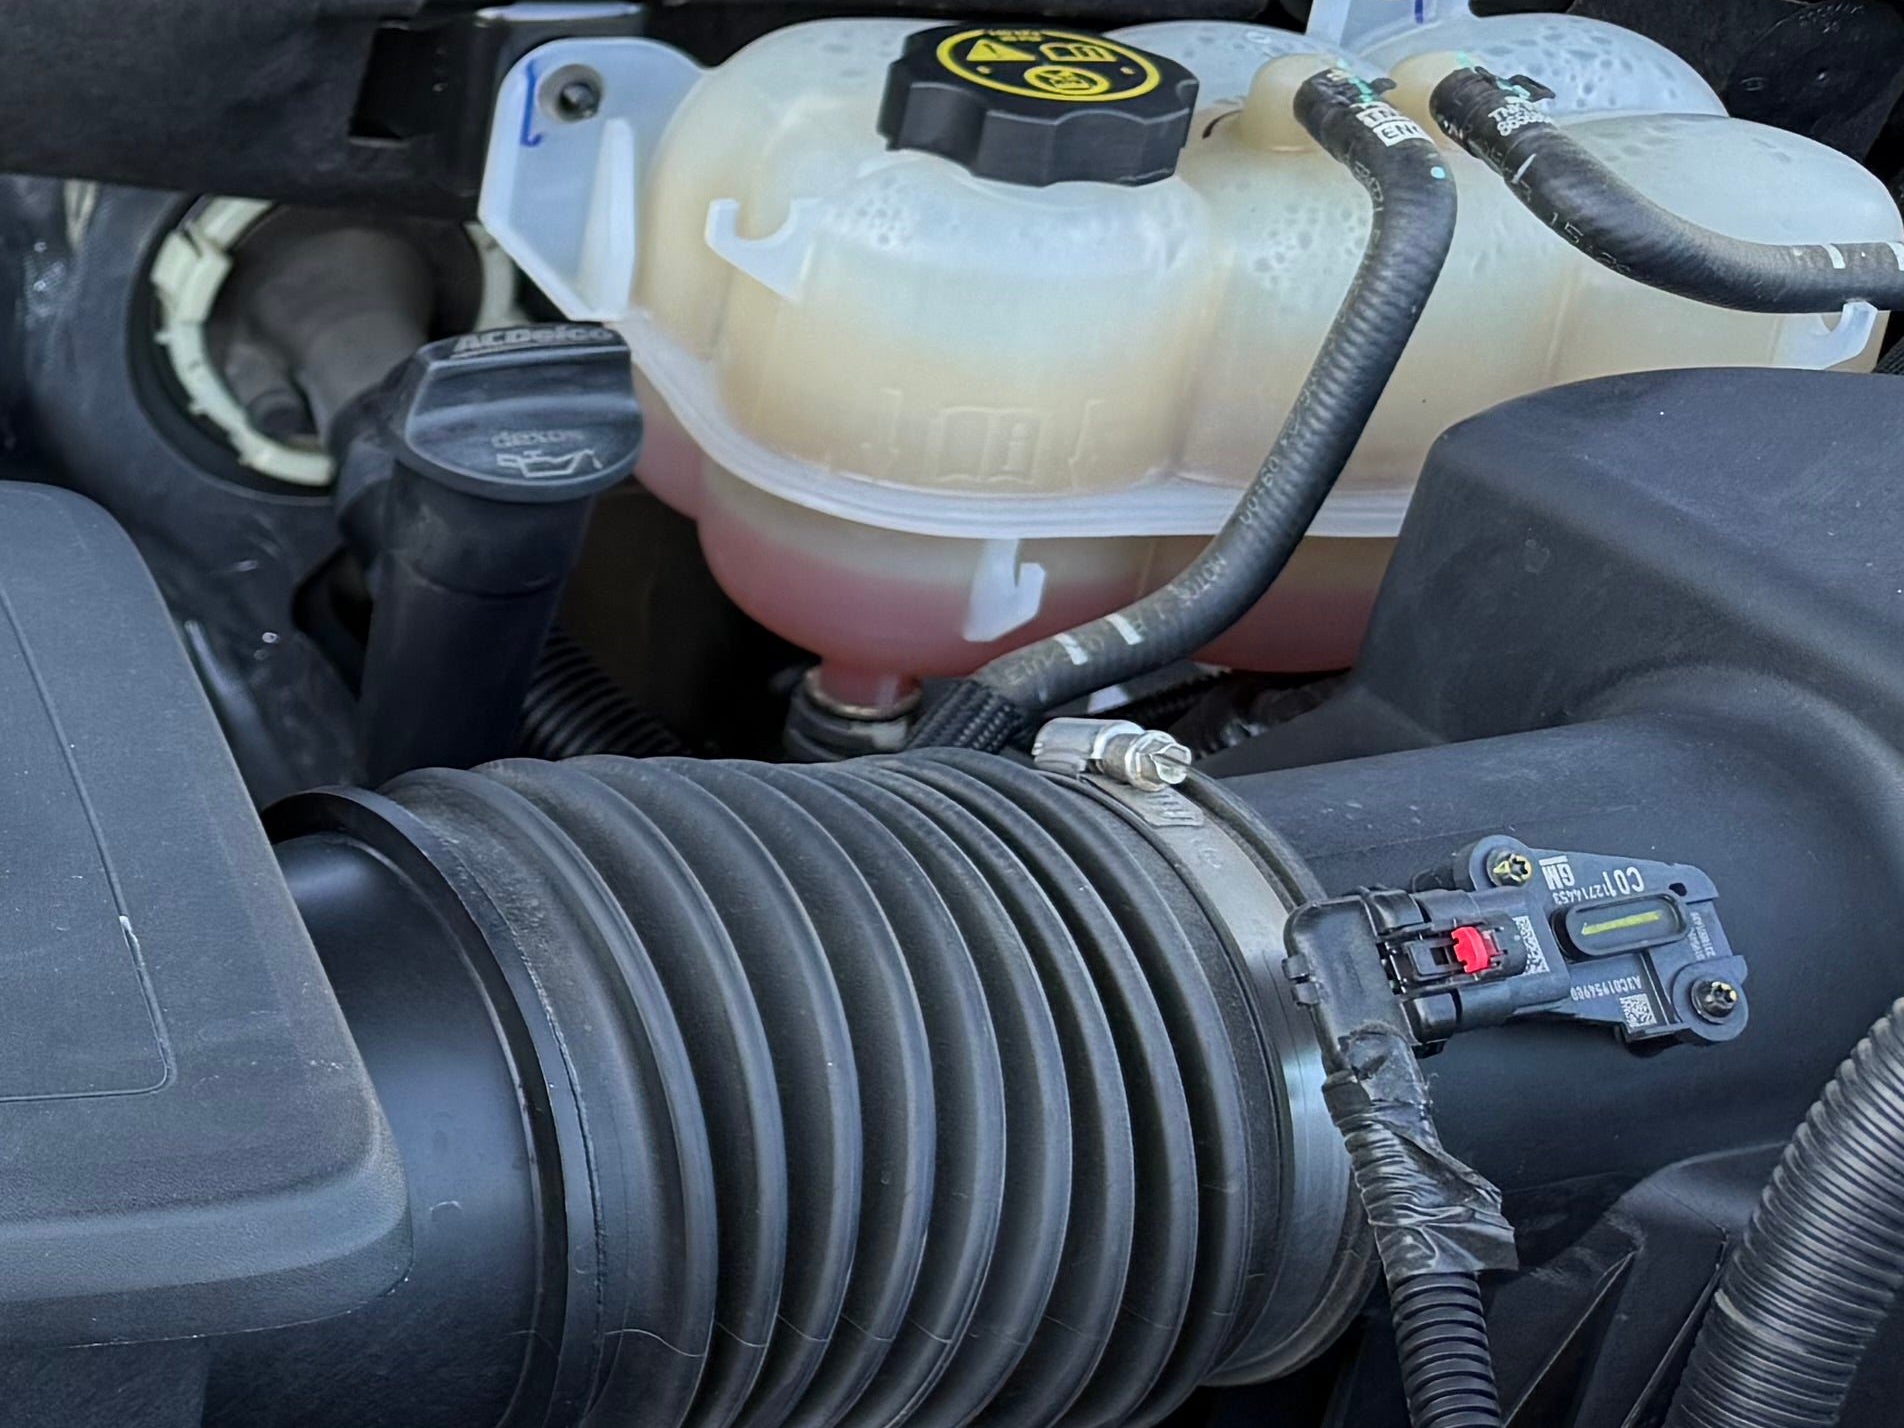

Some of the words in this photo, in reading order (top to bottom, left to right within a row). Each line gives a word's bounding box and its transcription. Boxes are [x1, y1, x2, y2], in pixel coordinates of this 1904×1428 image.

[453, 326, 614, 353] ACDelco
[494, 429, 585, 449] dexos
[1541, 862, 1576, 891] GM
[1602, 866, 1645, 897] C01
